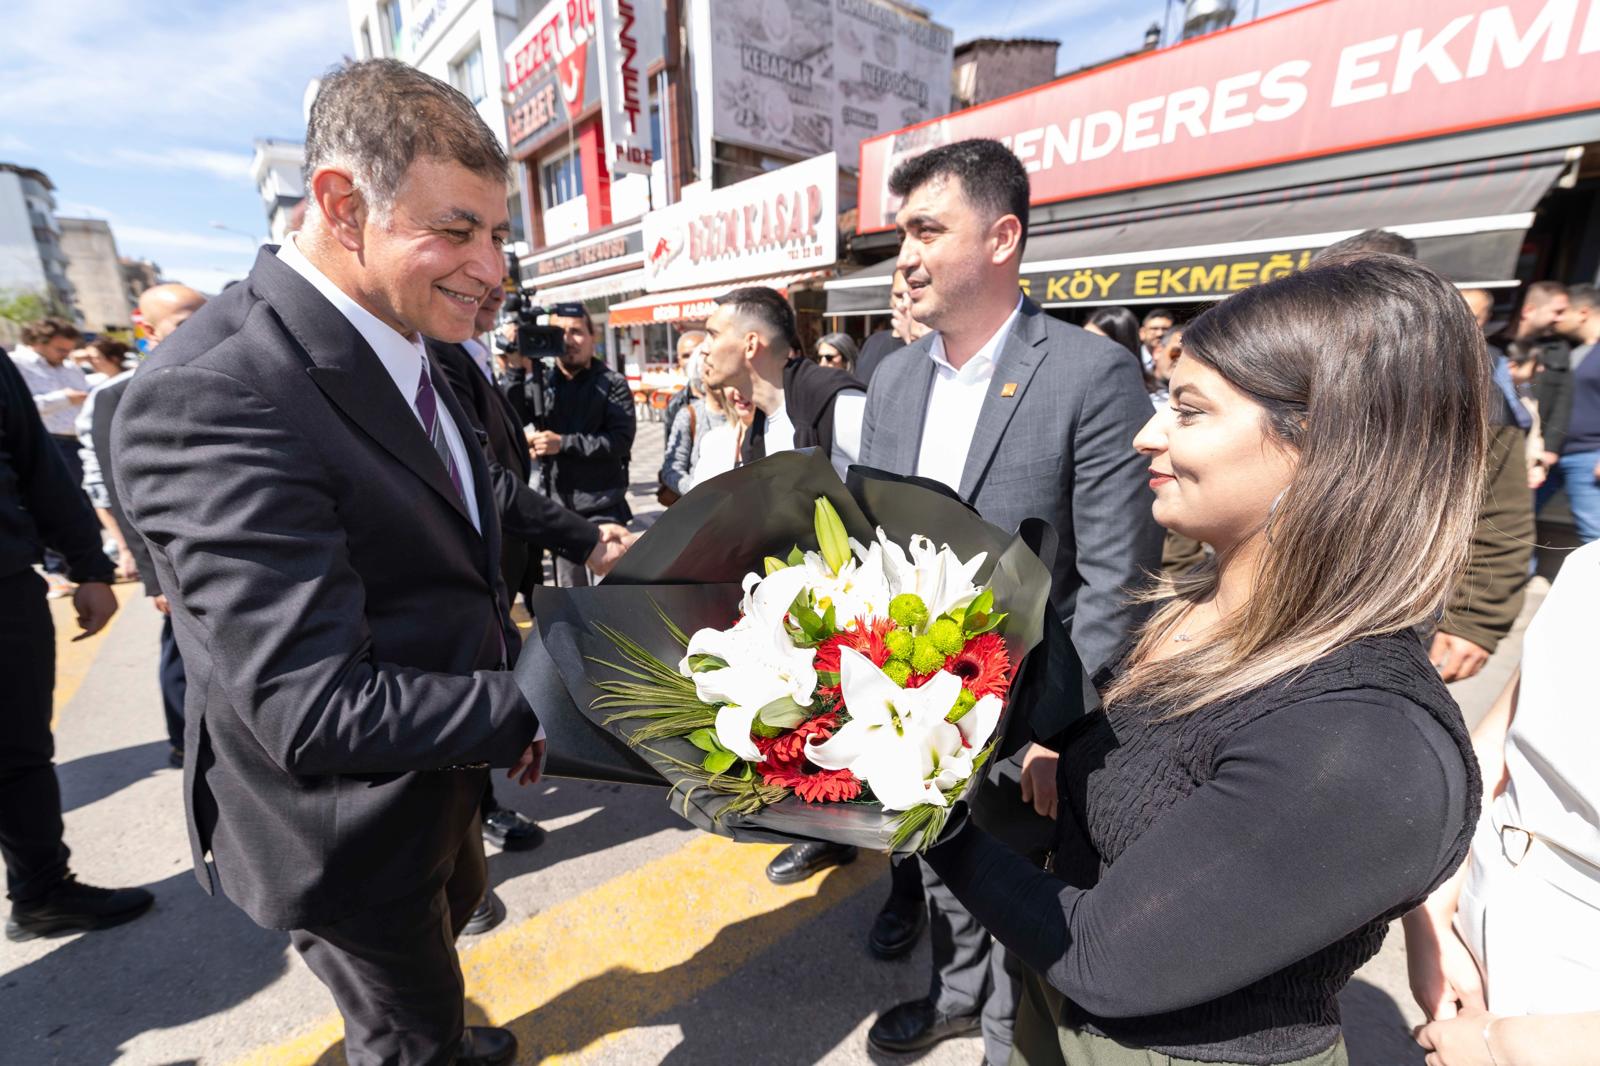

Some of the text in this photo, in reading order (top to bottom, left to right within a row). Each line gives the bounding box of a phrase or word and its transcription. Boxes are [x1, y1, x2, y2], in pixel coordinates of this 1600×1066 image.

[741, 43, 814, 92] KEBAPLAR
[1001, 59, 1312, 174] ENDERES
[743, 184, 823, 256] KASAP
[1046, 269, 1121, 300] KÖY
